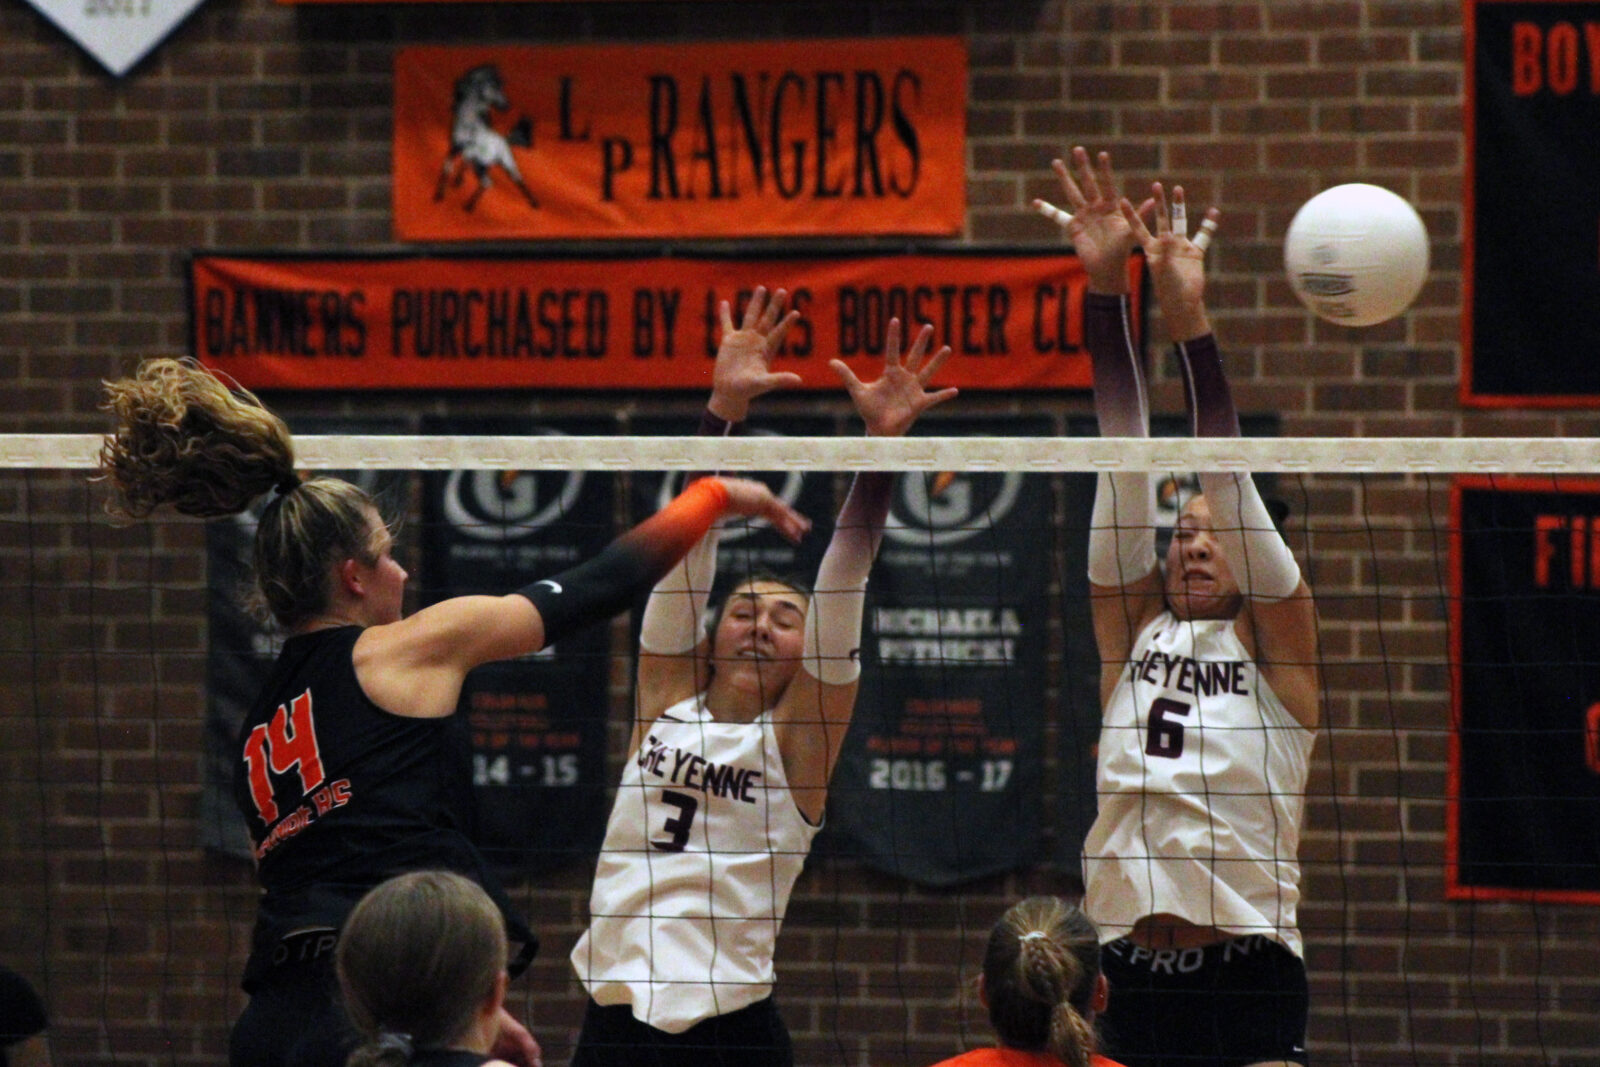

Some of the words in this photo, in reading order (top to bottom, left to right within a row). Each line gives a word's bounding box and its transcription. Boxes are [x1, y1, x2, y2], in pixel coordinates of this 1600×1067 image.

[559, 76, 590, 142] L
[646, 69, 922, 201] RANGERS
[204, 287, 367, 358] BANNERS
[393, 288, 610, 358] PURCHASED
[632, 287, 682, 358] BY
[838, 282, 1010, 356] BOOSTER
[1033, 282, 1092, 356] CL
[243, 687, 325, 826] 14
[1145, 697, 1191, 759] 6
[543, 754, 579, 786] 15
[869, 759, 946, 791] 2016
[981, 760, 1013, 792] 17
[650, 789, 698, 853] 3
